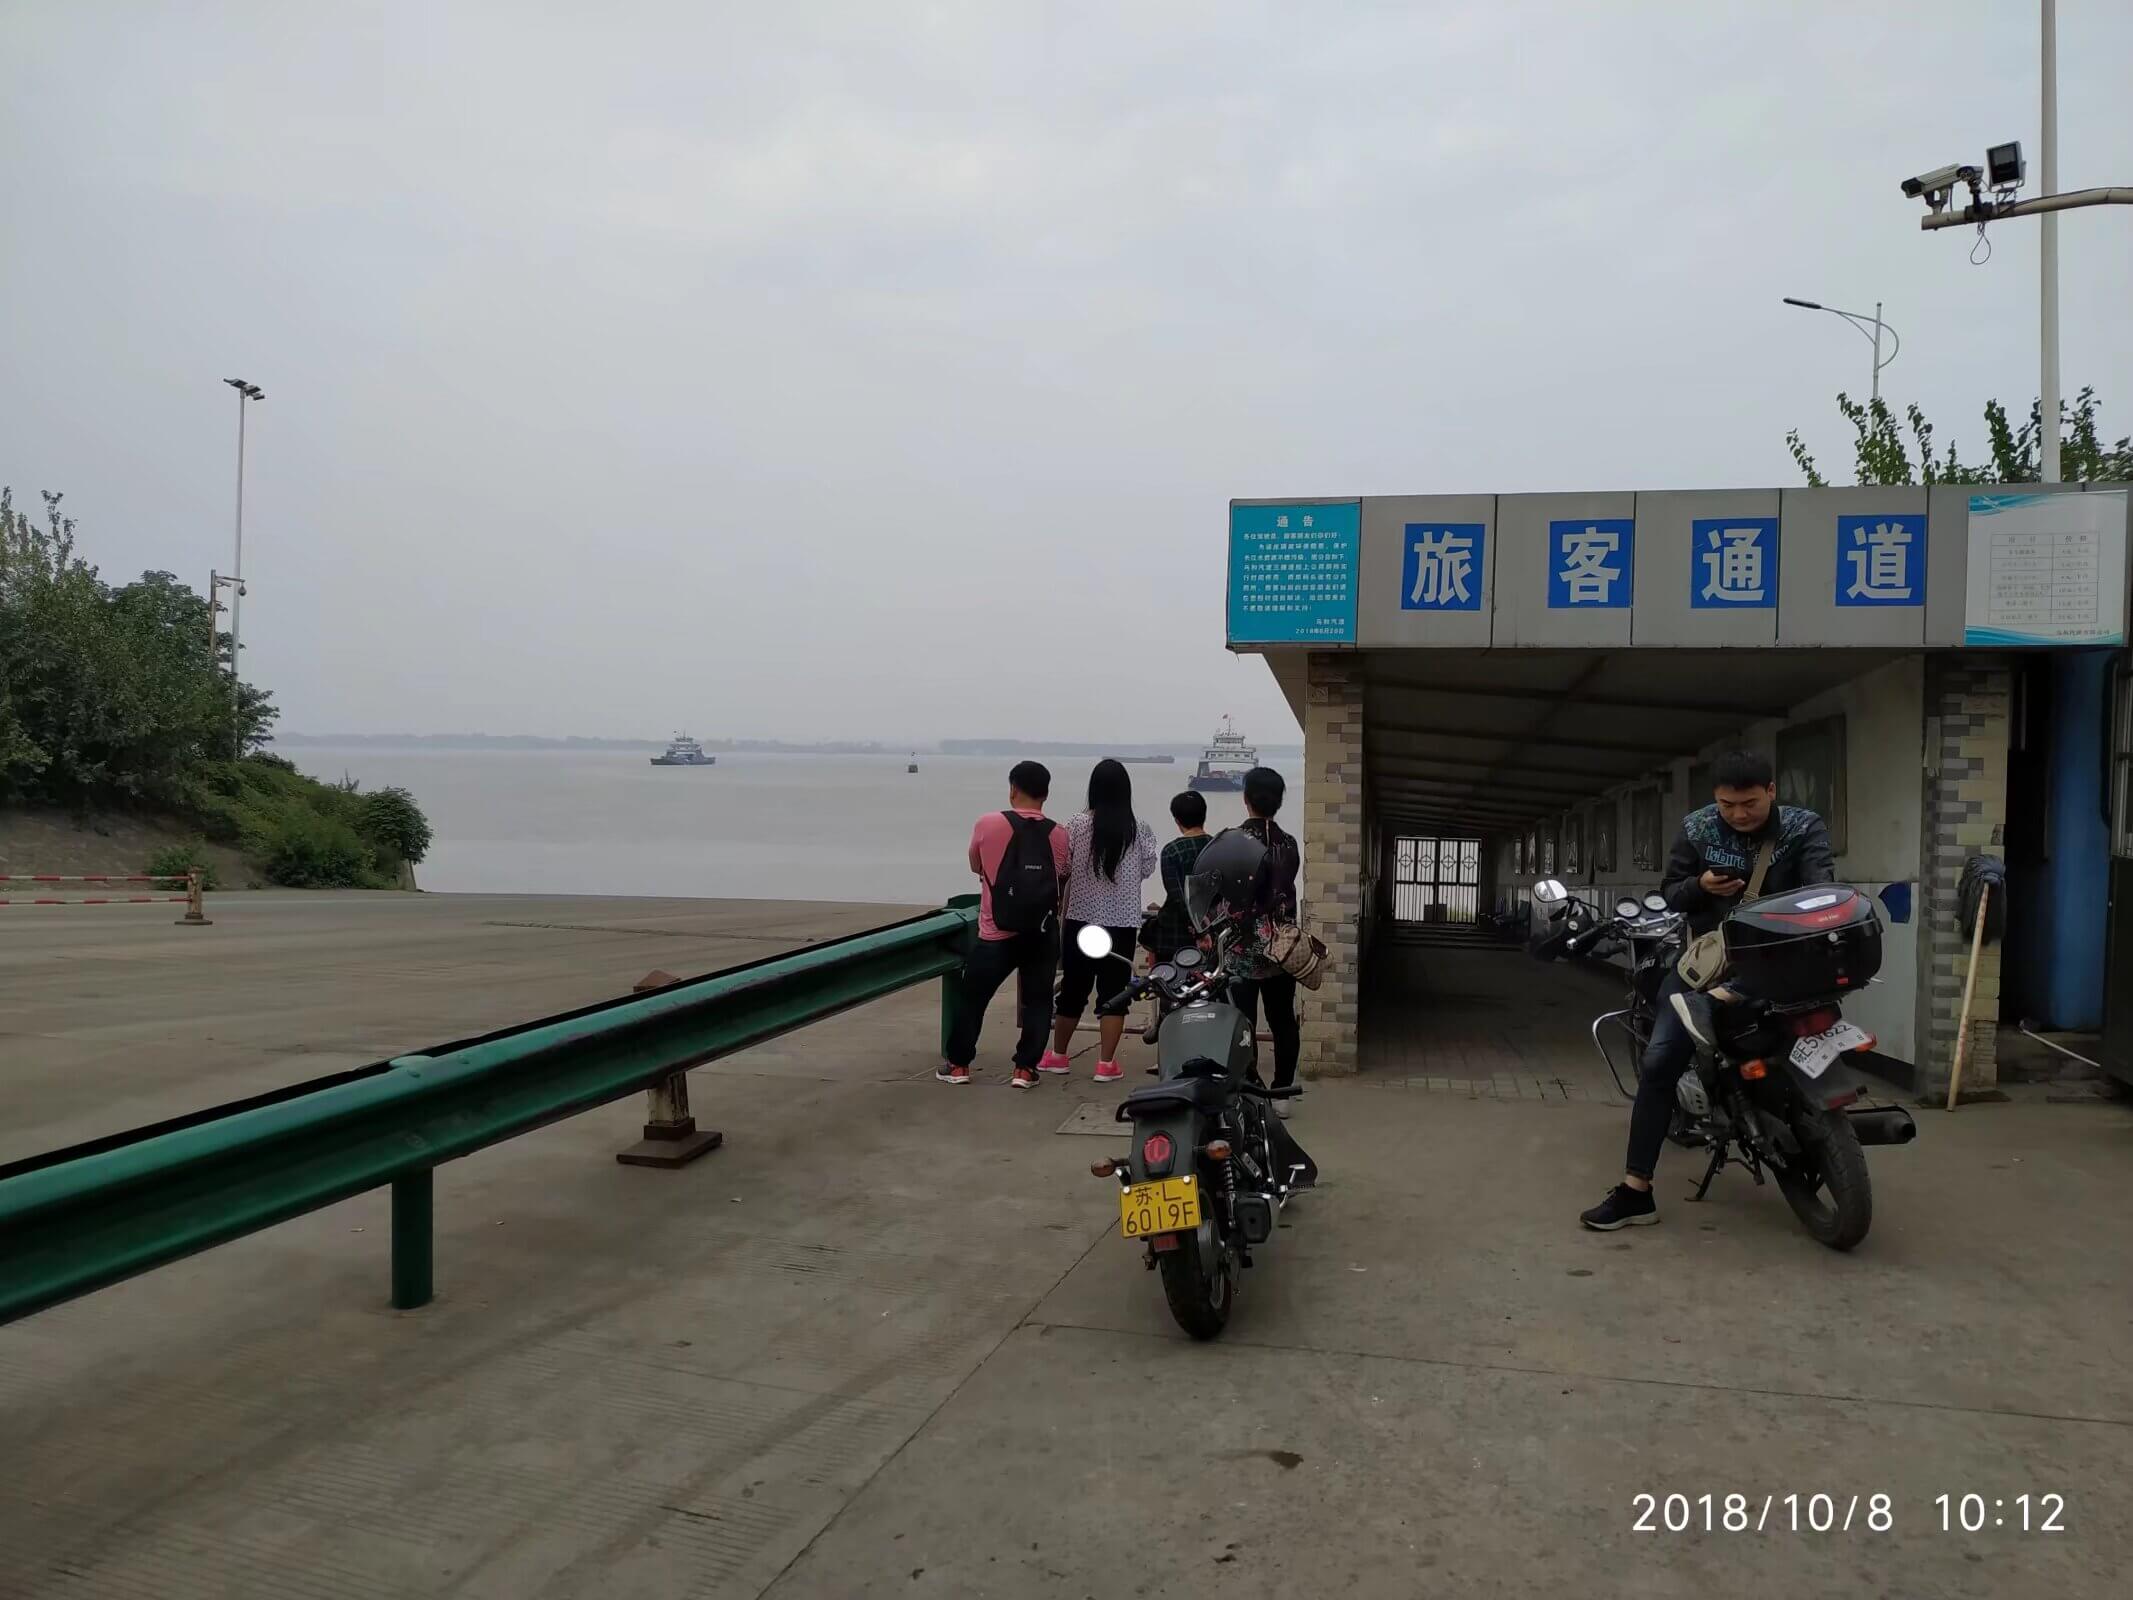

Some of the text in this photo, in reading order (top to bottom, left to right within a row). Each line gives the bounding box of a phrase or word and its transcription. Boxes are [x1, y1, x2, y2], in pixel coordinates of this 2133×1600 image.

[1410, 522, 1913, 606] 旅客通道
[1134, 1183, 1182, 1207] 苏·L
[1126, 1201, 1194, 1234] 6019F
